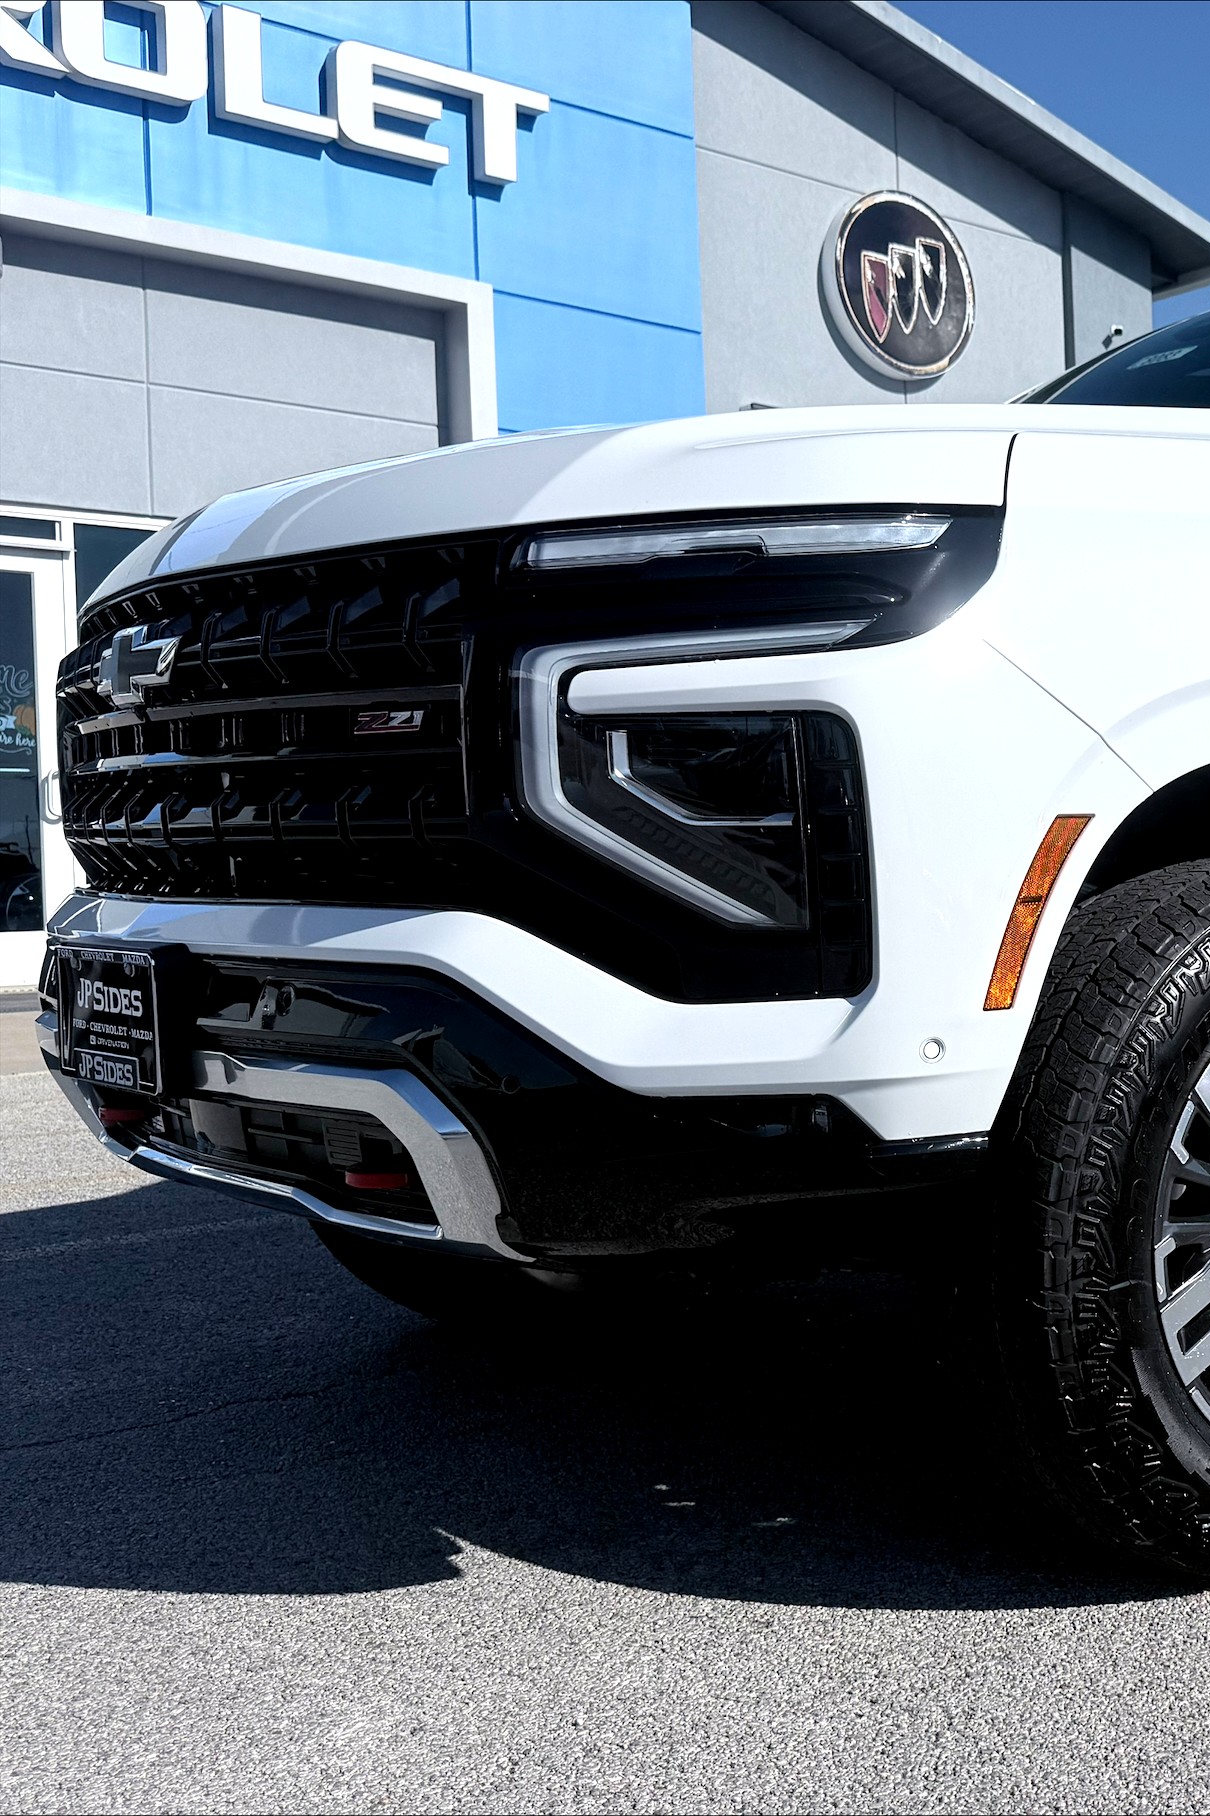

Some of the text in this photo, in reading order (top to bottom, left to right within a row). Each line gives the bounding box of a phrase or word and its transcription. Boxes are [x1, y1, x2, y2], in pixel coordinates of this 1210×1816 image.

[354, 710, 424, 734] Z71
[15, 733, 36, 747] here
[57, 948, 145, 965] FORD CHEVROLET MAZDA
[73, 1018, 153, 1040] FORD CHEVROLET MAZDA
